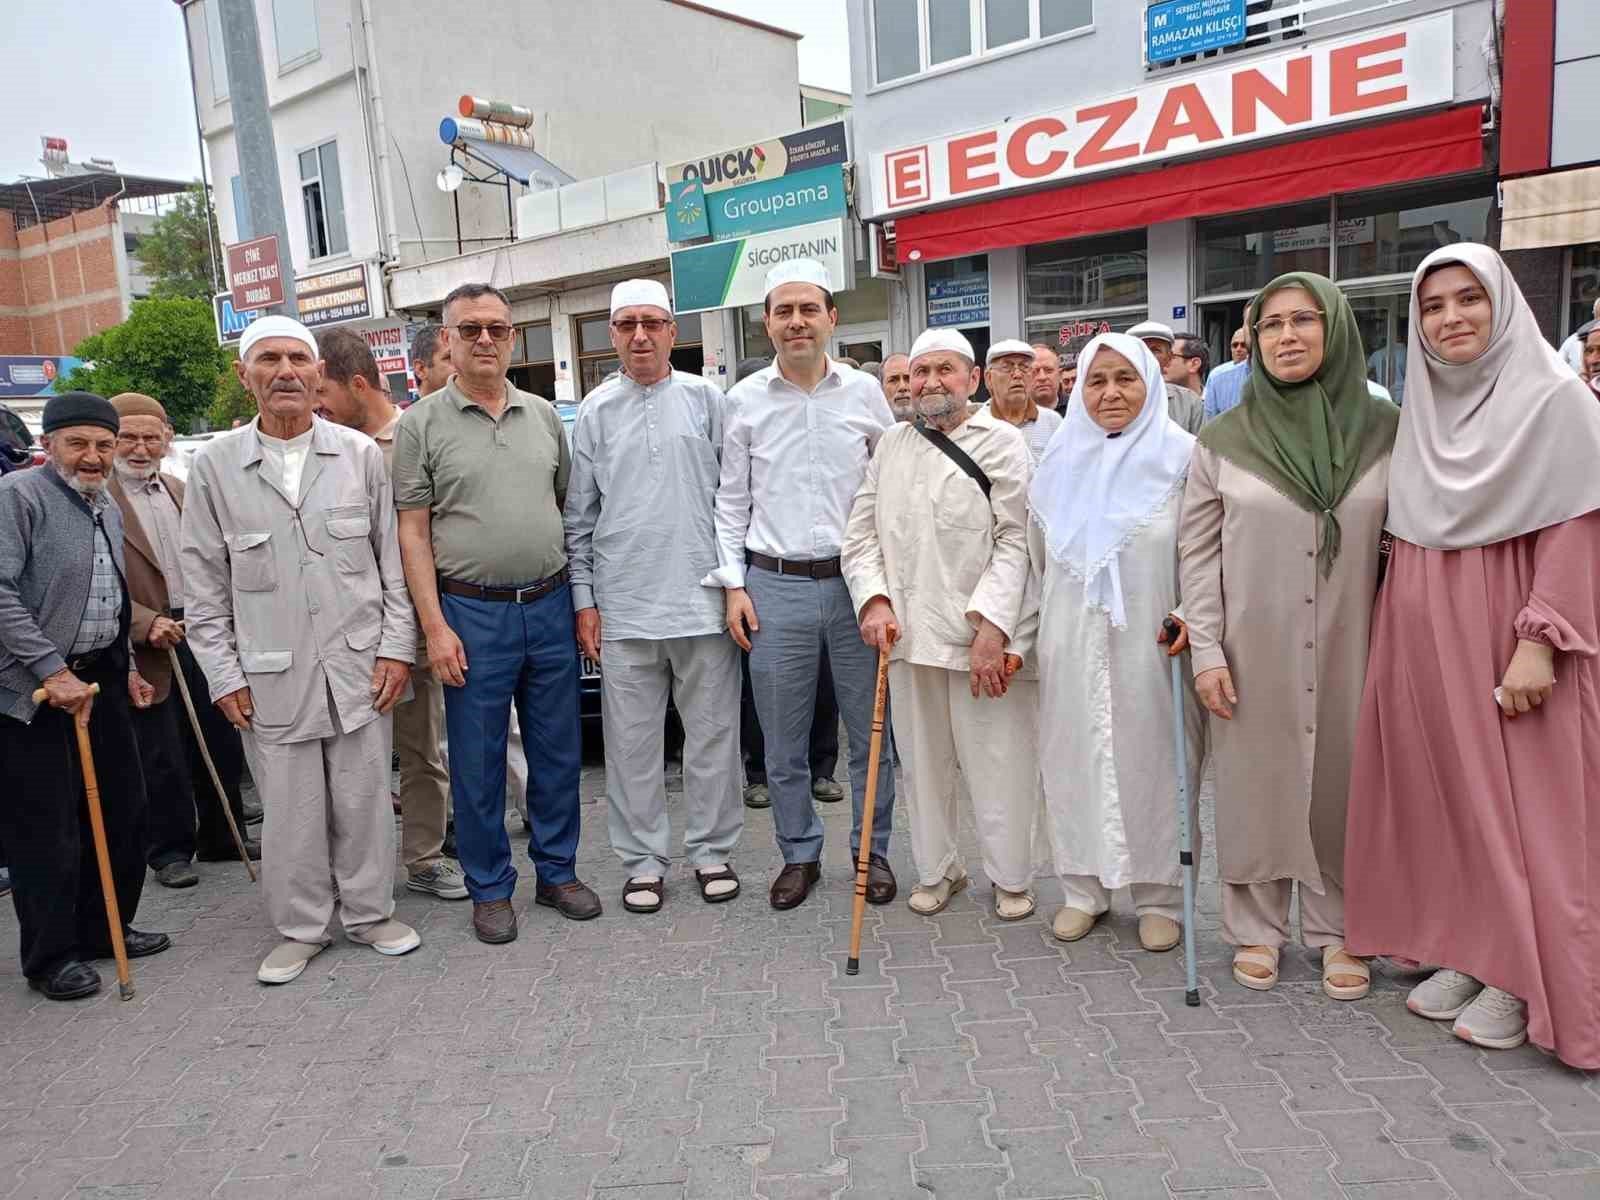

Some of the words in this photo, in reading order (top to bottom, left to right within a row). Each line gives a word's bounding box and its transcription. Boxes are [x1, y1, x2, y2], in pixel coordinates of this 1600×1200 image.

[1152, 25, 1203, 48] RAMAZAN
[1205, 15, 1241, 34] KILIŞÇI
[1154, 14, 1167, 28] M
[947, 32, 1408, 195] ECZANE
[682, 148, 756, 185] QUICK
[893, 155, 923, 198] E
[724, 184, 829, 219] Groupama
[245, 247, 260, 266] ÇİNE
[747, 236, 837, 267] SİGORTANIN
[233, 270, 259, 288] MERKEZ
[258, 263, 279, 282] TAKSİ
[246, 285, 271, 304] DURAĞI
[1058, 320, 1113, 346] ŞİFA
